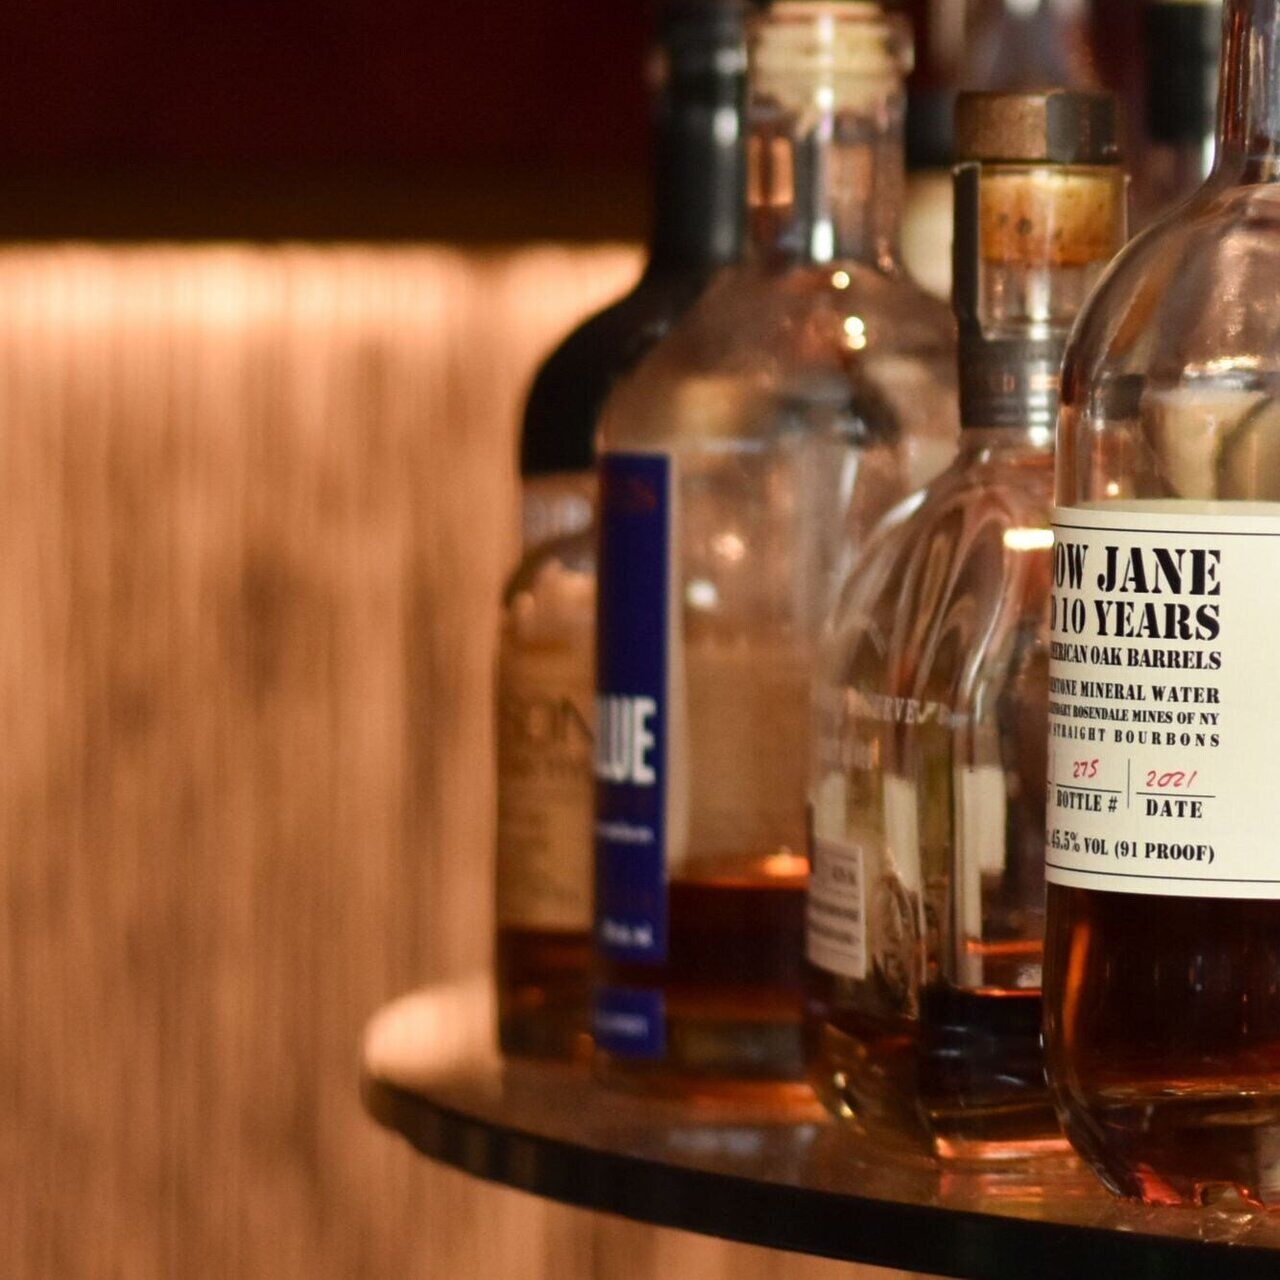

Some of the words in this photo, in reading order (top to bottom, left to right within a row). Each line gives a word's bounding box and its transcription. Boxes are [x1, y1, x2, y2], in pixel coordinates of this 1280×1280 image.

[1096, 545, 1222, 596] JANE
[1061, 597, 1087, 634] 10
[1093, 599, 1221, 642] YEARS
[1090, 645, 1122, 666] OAK
[1126, 647, 1222, 671] BARRELS
[1080, 680, 1146, 702] MINERAL
[1151, 685, 1221, 704] WATER
[1073, 704, 1129, 723] ROSENDALE
[1132, 709, 1173, 725] MINES
[1176, 711, 1196, 726] OF
[1199, 712, 1220, 726] NY
[1052, 722, 1106, 743] STRAIGHT
[1114, 728, 1220, 748] BOURBONS
[1056, 789, 1103, 813] BOTTLE
[1145, 798, 1203, 819] DATE
[1083, 836, 1109, 856] VOL
[1113, 839, 1138, 859] (91
[1144, 841, 1216, 865] PROOF)
